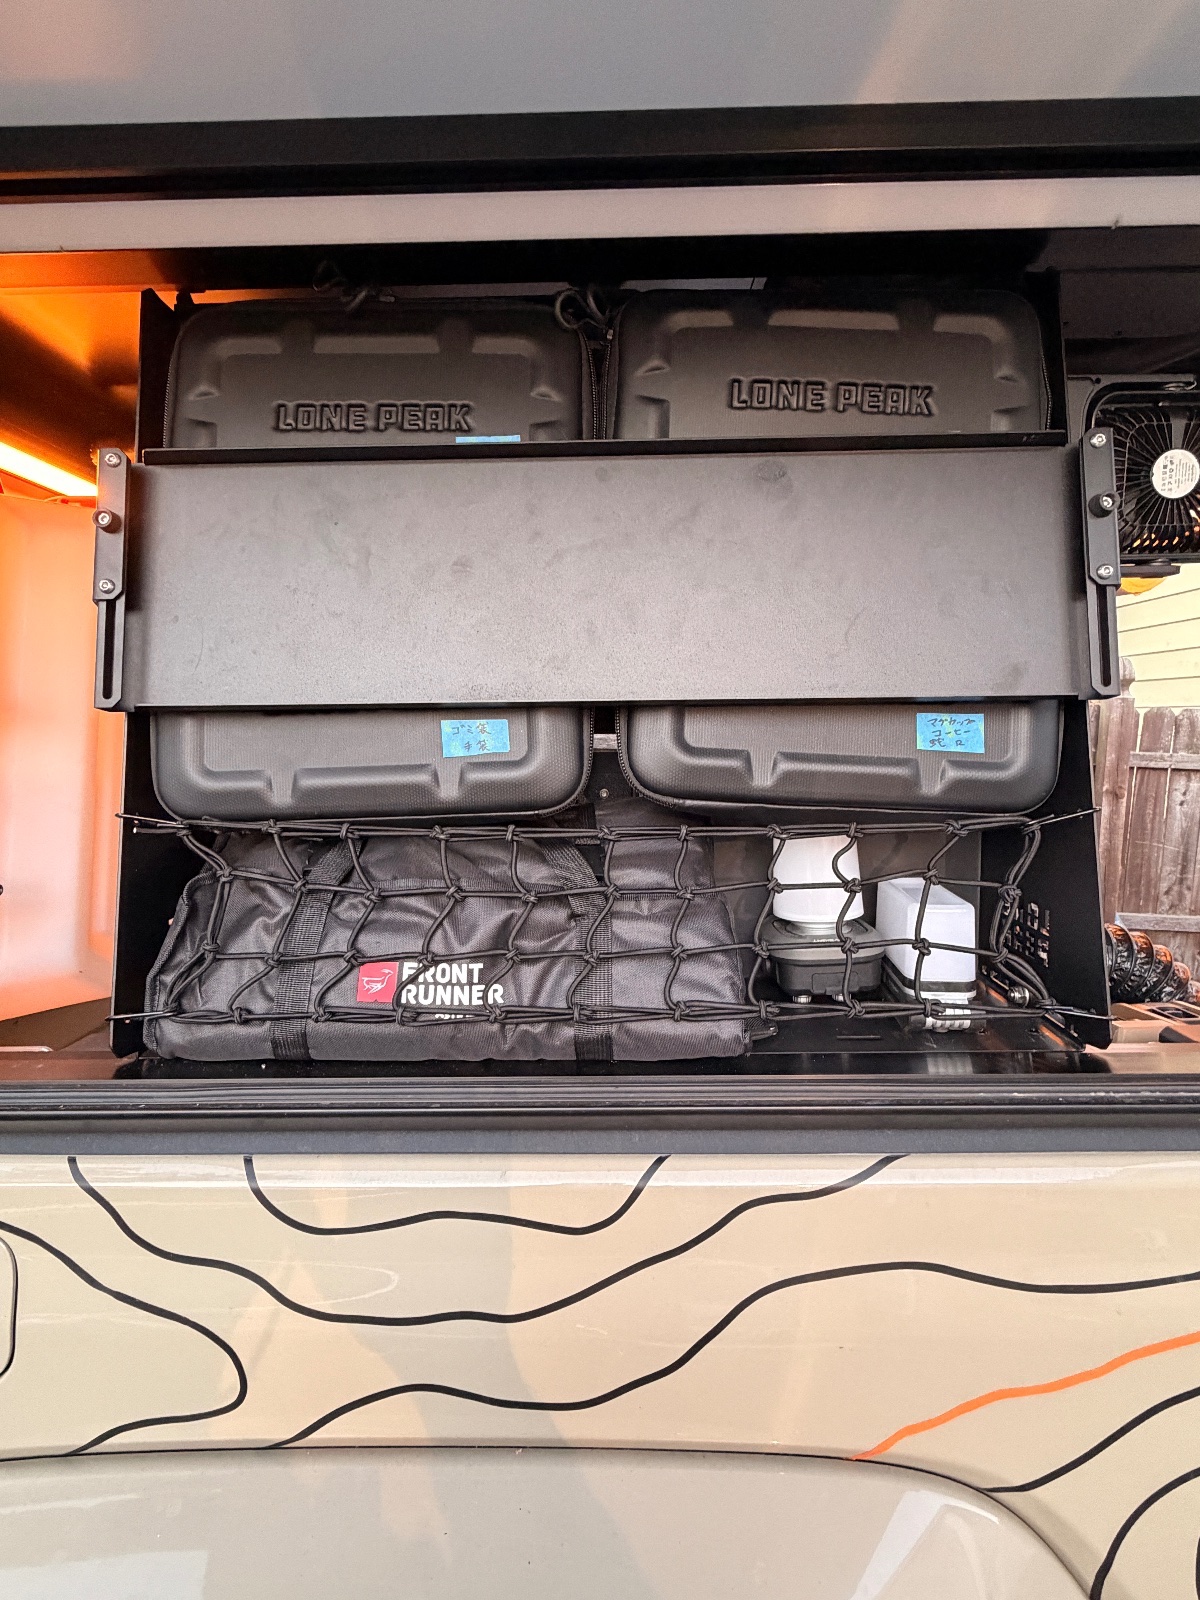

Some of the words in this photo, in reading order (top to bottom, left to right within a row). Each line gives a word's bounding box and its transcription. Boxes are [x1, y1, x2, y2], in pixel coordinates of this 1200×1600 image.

[730, 378, 826, 412] LONE
[836, 381, 933, 416] PEAK
[276, 402, 367, 432] LONE
[377, 402, 471, 432] PEAK
[451, 722, 492, 735] ゴミ袋
[931, 728, 971, 737] コーヒー
[464, 739, 491, 752] 手袋
[402, 962, 484, 984] FRONT
[401, 984, 504, 1006] RUNNER
